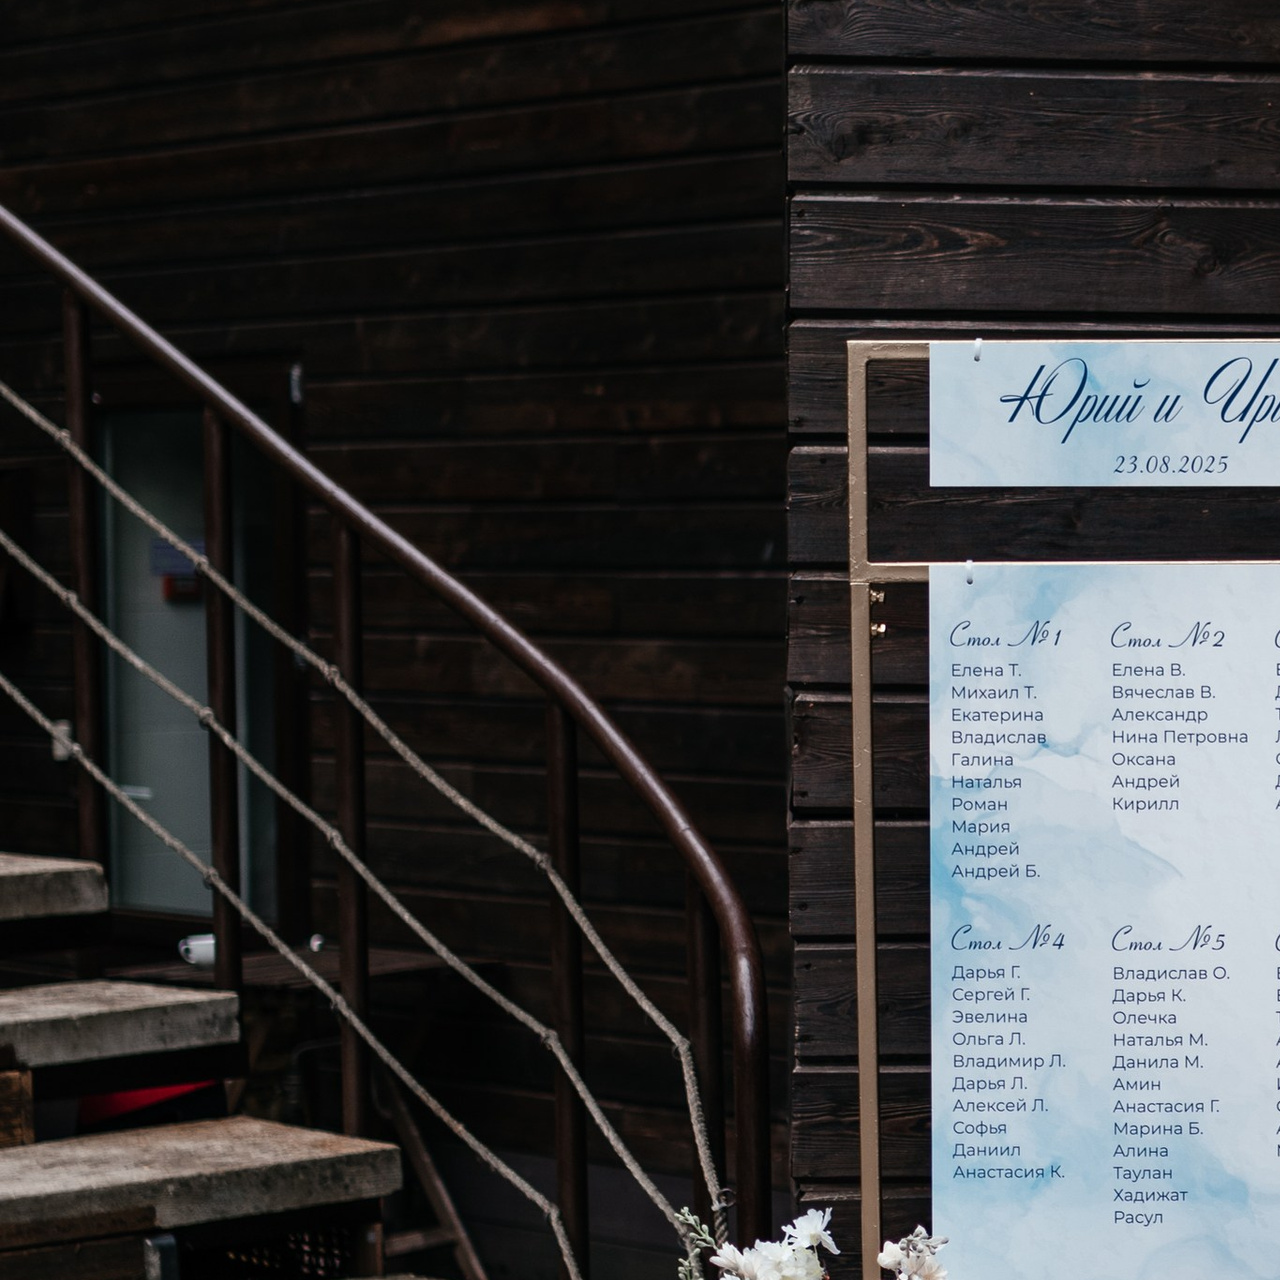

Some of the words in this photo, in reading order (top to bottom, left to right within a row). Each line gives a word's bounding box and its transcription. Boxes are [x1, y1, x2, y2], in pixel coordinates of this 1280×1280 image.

[1000, 358, 1150, 444] Юрий
[1153, 394, 1183, 424] и
[1113, 455, 1229, 474] 23.08.2025
[950, 620, 1001, 647] Стол
[1111, 622, 1162, 648] Стол
[952, 663, 1004, 677] Елена
[1008, 663, 1021, 676] Т.
[1113, 663, 1164, 676] Елена
[1171, 663, 1185, 676] В.
[952, 686, 1018, 699] Михаил
[1024, 686, 1037, 699] Т.
[1113, 686, 1195, 699] Вячеслав
[1201, 685, 1215, 699] В.
[952, 708, 1043, 725] Екатерина
[1112, 708, 1208, 724] Александр
[952, 730, 1046, 746] Владислав
[1113, 730, 1157, 743] Нина
[1164, 730, 1248, 746] Петровна
[952, 752, 1014, 766] Галина
[1112, 752, 1175, 766] Оксана
[952, 775, 1021, 789] Наталья
[1112, 774, 1179, 791] Андрей
[952, 797, 1007, 811] Роман
[1113, 797, 1179, 813] Кирилл
[952, 820, 1010, 836] Мария
[951, 841, 1019, 859] Андрей
[951, 864, 1019, 880] Андрей
[1026, 864, 1040, 877] Б.
[951, 924, 1002, 950] Стол
[1112, 925, 1163, 951] Стол
[952, 966, 1005, 982] Дарья
[1012, 965, 1020, 979] Г.
[1114, 967, 1208, 983] Владислав
[1213, 966, 1230, 979] О.
[952, 987, 1014, 1004] Сергей
[1021, 988, 1030, 1001] Г.
[1112, 989, 1165, 1005] Дарья
[1172, 989, 1186, 1002] К.
[952, 1010, 1027, 1023] Эвелина
[1113, 1011, 1176, 1024] Олечка
[953, 1032, 1004, 1045] Ольга
[1008, 1032, 1025, 1045] Л.
[1114, 1033, 1183, 1047] Наталья
[1189, 1033, 1208, 1046] М.
[954, 1054, 1044, 1070] Владимир
[1049, 1054, 1065, 1067] Л.
[1112, 1055, 1179, 1071] Данила
[1185, 1055, 1203, 1068] М.
[952, 1077, 1005, 1093] Дарья
[1010, 1076, 1027, 1090] Л.
[1113, 1078, 1160, 1091] Амин
[953, 1098, 1026, 1112] Алексей
[1032, 1099, 1048, 1112] Л.
[1113, 1100, 1204, 1113] Анастасия
[1211, 1100, 1219, 1112] Г.
[953, 1120, 1006, 1137] Софья
[1114, 1122, 1183, 1138] Марина
[1188, 1121, 1203, 1135] Б.
[952, 1143, 1020, 1159] Даниил
[1113, 1144, 1168, 1157] Алина
[953, 1165, 1044, 1179] Анастасия
[1050, 1165, 1065, 1178] К.
[1113, 1166, 1172, 1183] Таулан
[1113, 1188, 1188, 1204] Хадижат
[1115, 1211, 1163, 1227] Расул
